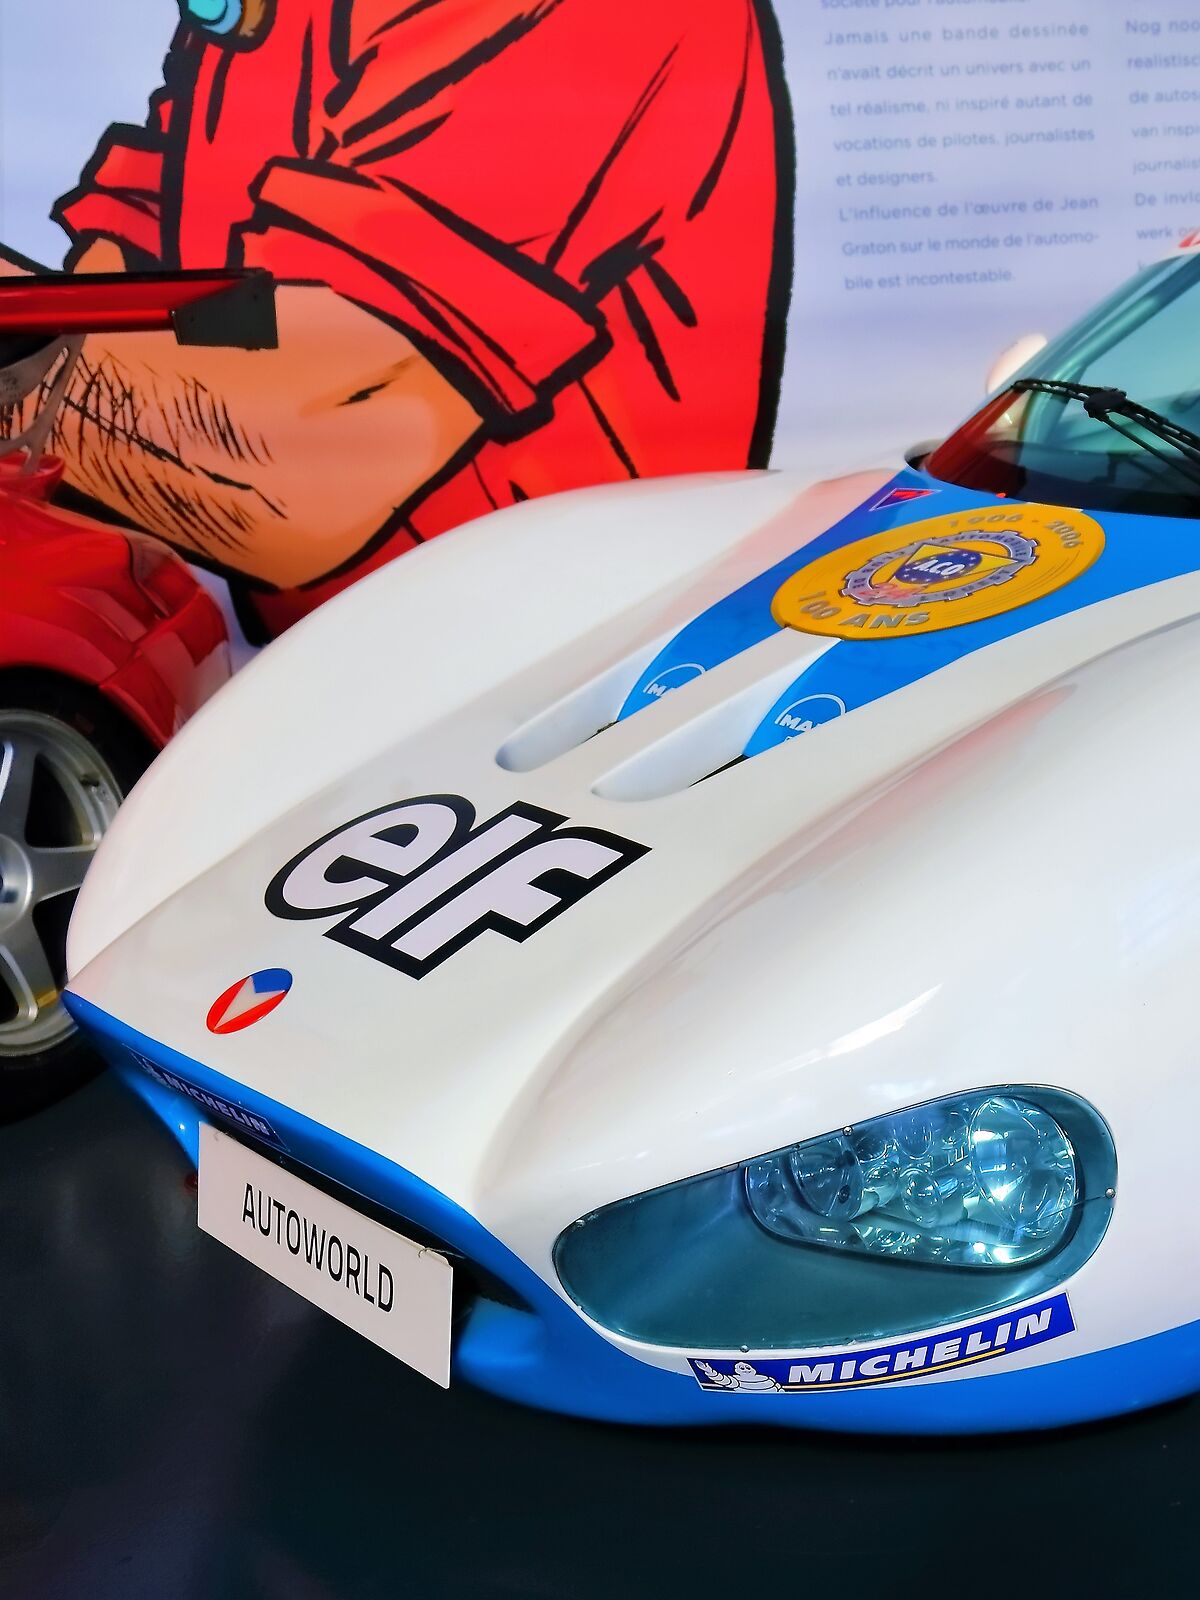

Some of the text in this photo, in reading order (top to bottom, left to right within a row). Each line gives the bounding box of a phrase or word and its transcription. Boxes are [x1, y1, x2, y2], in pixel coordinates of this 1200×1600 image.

[824, 22, 1090, 46] Jamais une bande dessinée
[1126, 20, 1161, 35] Nog
[886, 63, 934, 79] décrit
[940, 65, 960, 77] un
[966, 60, 1024, 76] univers
[1028, 61, 1065, 74] avec
[1071, 59, 1092, 72] un
[830, 103, 851, 117] tel
[935, 98, 951, 112] ni
[955, 95, 1009, 113] inspiré
[1015, 94, 1066, 109] autant
[1073, 92, 1093, 106] de
[1129, 90, 1149, 104] de
[833, 135, 912, 152] vocations
[917, 133, 937, 148] de
[1004, 127, 1095, 148] journalistes
[1132, 124, 1158, 138] van
[836, 174, 852, 187] et
[937, 202, 959, 217] de
[1033, 198, 1053, 212] de
[1060, 196, 1099, 211] Jean
[1135, 192, 1157, 206] De
[842, 241, 897, 257] Graton
[900, 241, 923, 254] sur
[928, 238, 941, 252] le
[945, 235, 1000, 250] monde
[1003, 233, 1022, 247] de
[1136, 226, 1173, 240] werk
[845, 276, 873, 290] bile
[877, 274, 901, 288] est
[950, 513, 1024, 527] 1906
[1045, 520, 1085, 549] 2006
[798, 591, 930, 629] 100 ANS
[264, 793, 652, 980] elf
[163, 1072, 270, 1136] MICHELIN
[241, 1182, 395, 1313] AUTOWORLD
[788, 1307, 1053, 1383] MICHELIN
